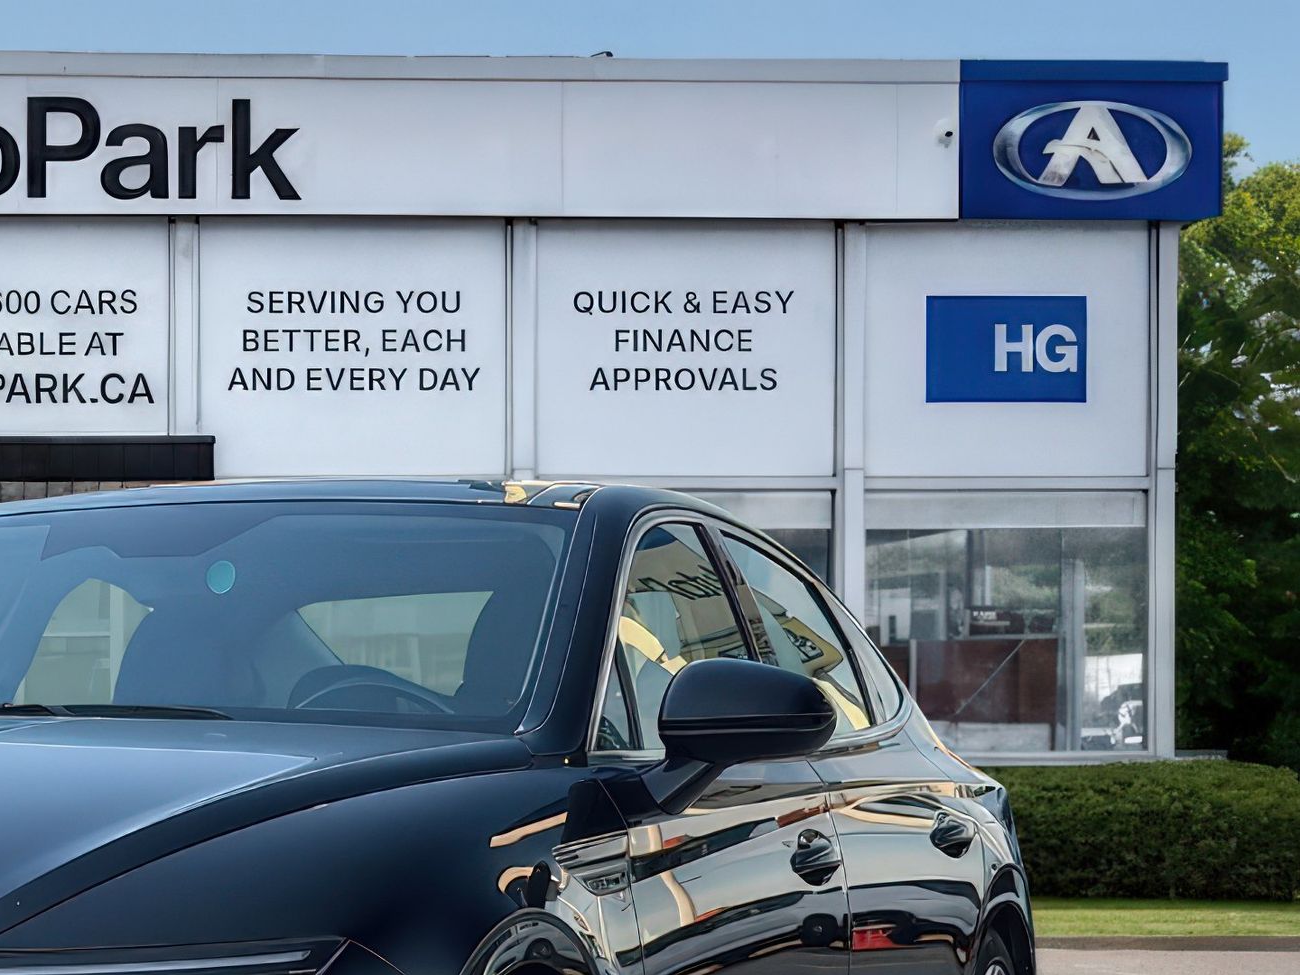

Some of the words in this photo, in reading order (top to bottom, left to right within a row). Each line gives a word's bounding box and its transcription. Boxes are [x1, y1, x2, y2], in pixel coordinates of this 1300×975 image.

[50, 289, 138, 316] CARS
[246, 290, 385, 314] SERVING
[395, 290, 461, 314] YOU
[573, 290, 673, 316] QUICK
[683, 290, 701, 314] &
[712, 290, 795, 314] EASY
[84, 331, 125, 357] AT
[242, 329, 370, 357] BETTER,
[381, 328, 467, 353] EACH
[614, 328, 753, 353] FINANCE
[994, 324, 1078, 373] HG
[228, 367, 295, 391] AND
[306, 367, 408, 391] EVERY
[419, 367, 481, 391] DAY
[590, 367, 778, 392] APPROVALS
